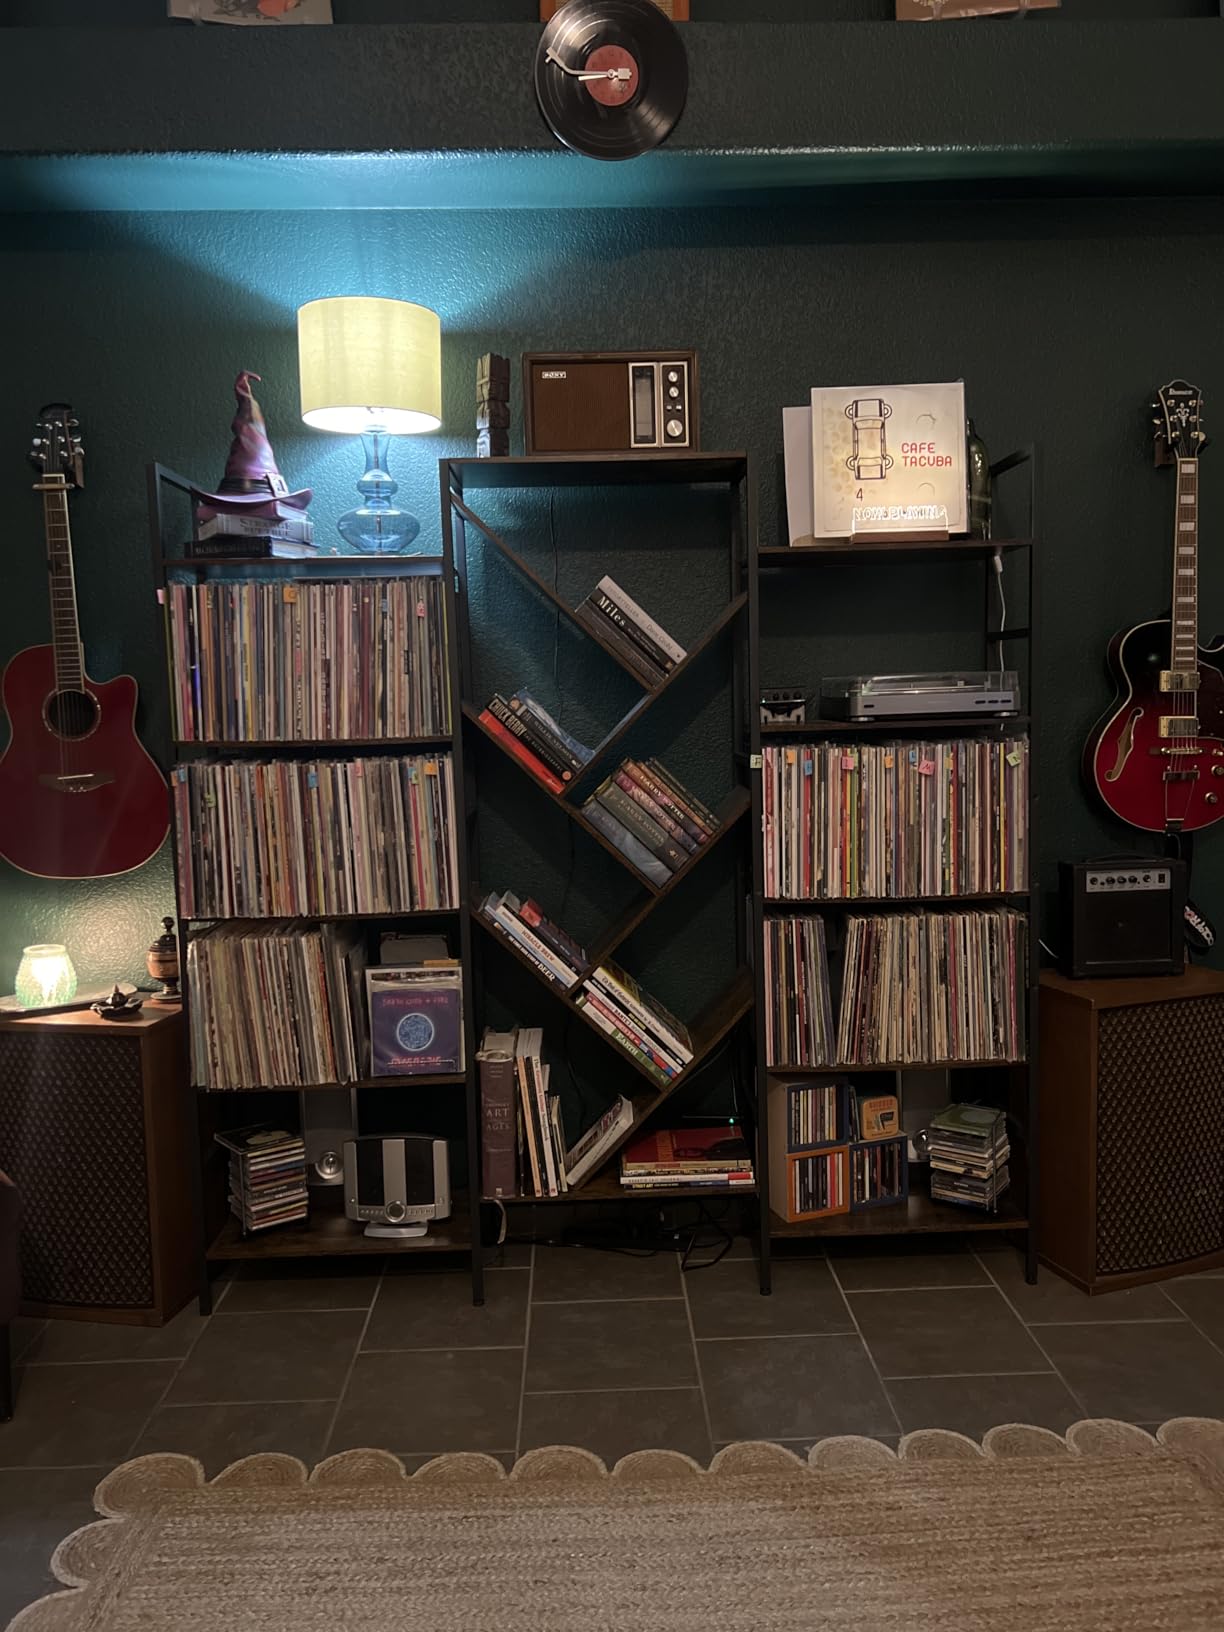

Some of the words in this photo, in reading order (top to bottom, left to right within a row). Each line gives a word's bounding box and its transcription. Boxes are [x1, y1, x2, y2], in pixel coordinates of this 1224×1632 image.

[901, 442, 935, 454] CAFE
[901, 455, 952, 467] TACUBA
[855, 487, 864, 501] 4
[595, 594, 630, 628] Miles
[485, 697, 512, 723] CHUCK
[503, 713, 528, 738] BERRY
[637, 774, 664, 798] HARRY
[536, 962, 556, 981] BEER
[615, 1032, 640, 1055] EARTH
[486, 1108, 508, 1117] ART
